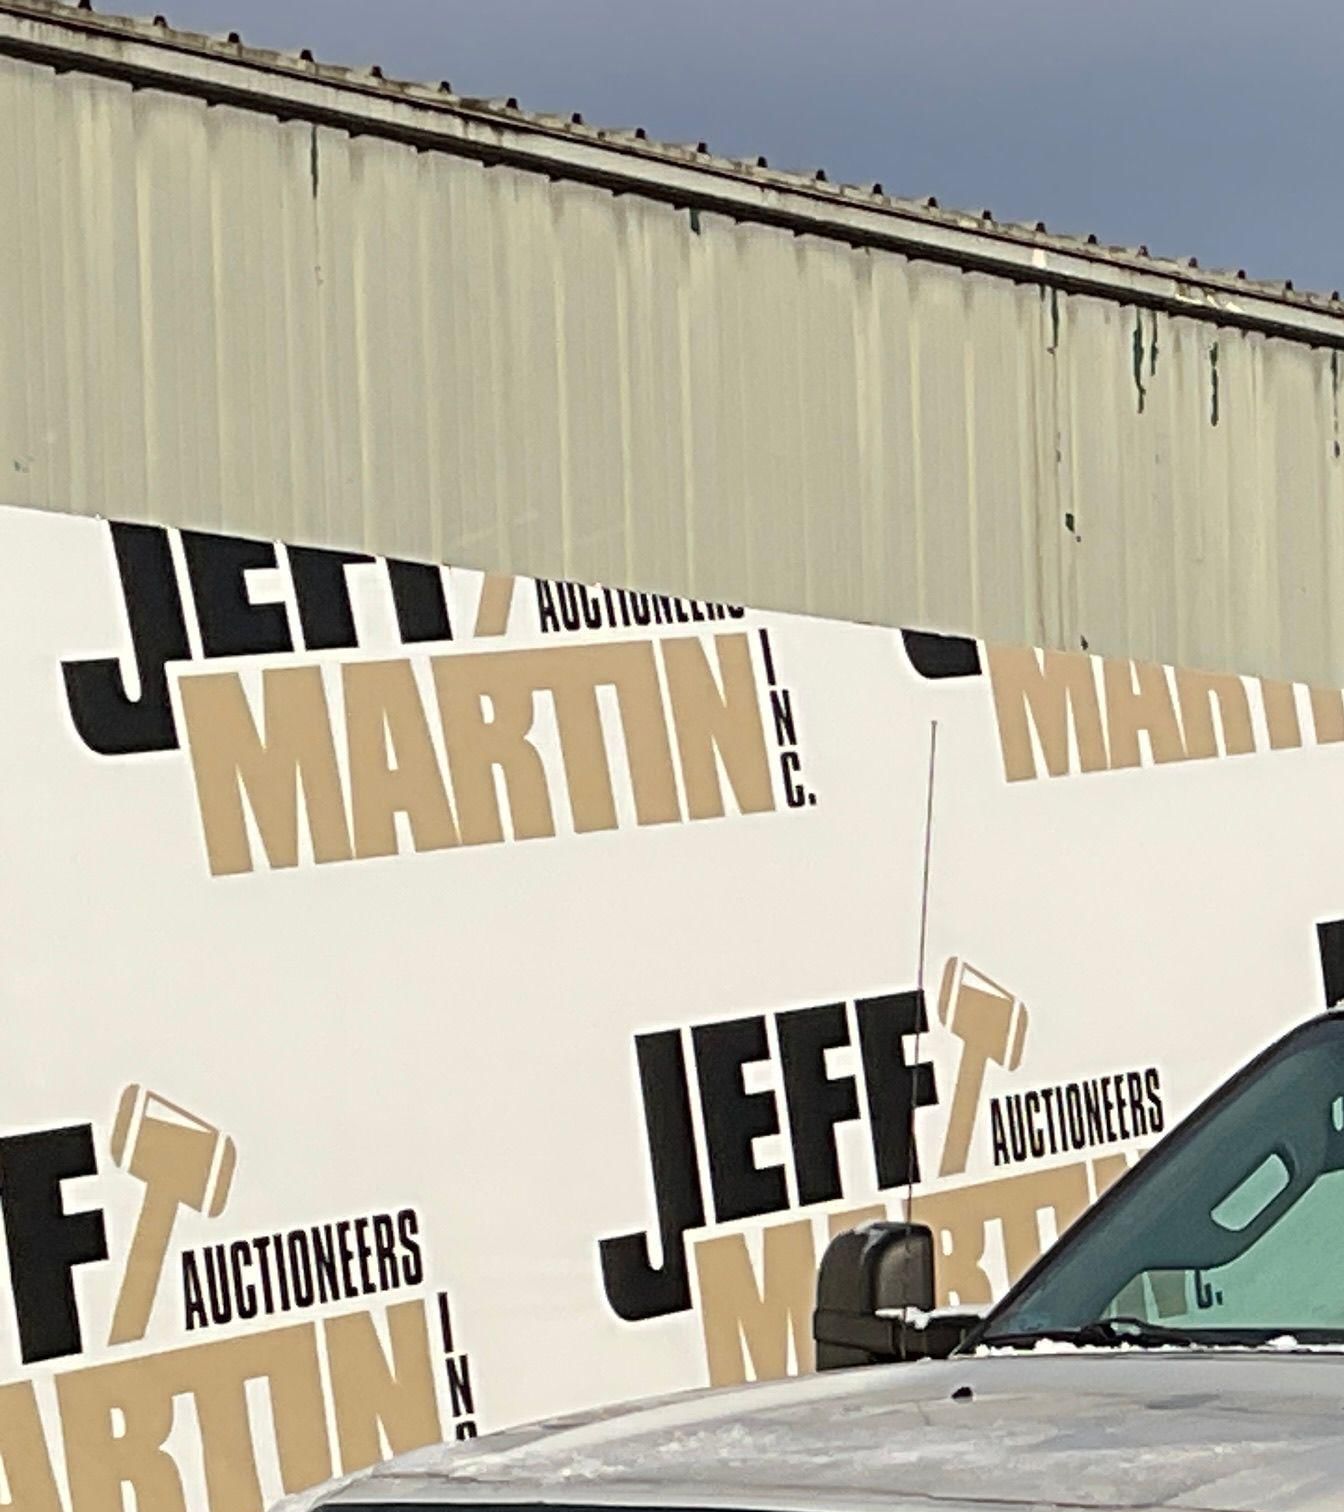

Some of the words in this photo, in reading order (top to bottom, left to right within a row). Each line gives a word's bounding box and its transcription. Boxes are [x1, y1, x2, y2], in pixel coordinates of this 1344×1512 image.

[177, 631, 777, 877] MARTIN
[758, 628, 817, 808] INC.
[598, 988, 939, 1322] JEFF
[990, 1067, 1165, 1166] AUCTIONEERS
[182, 1208, 424, 1332] AUCTIONEERS
